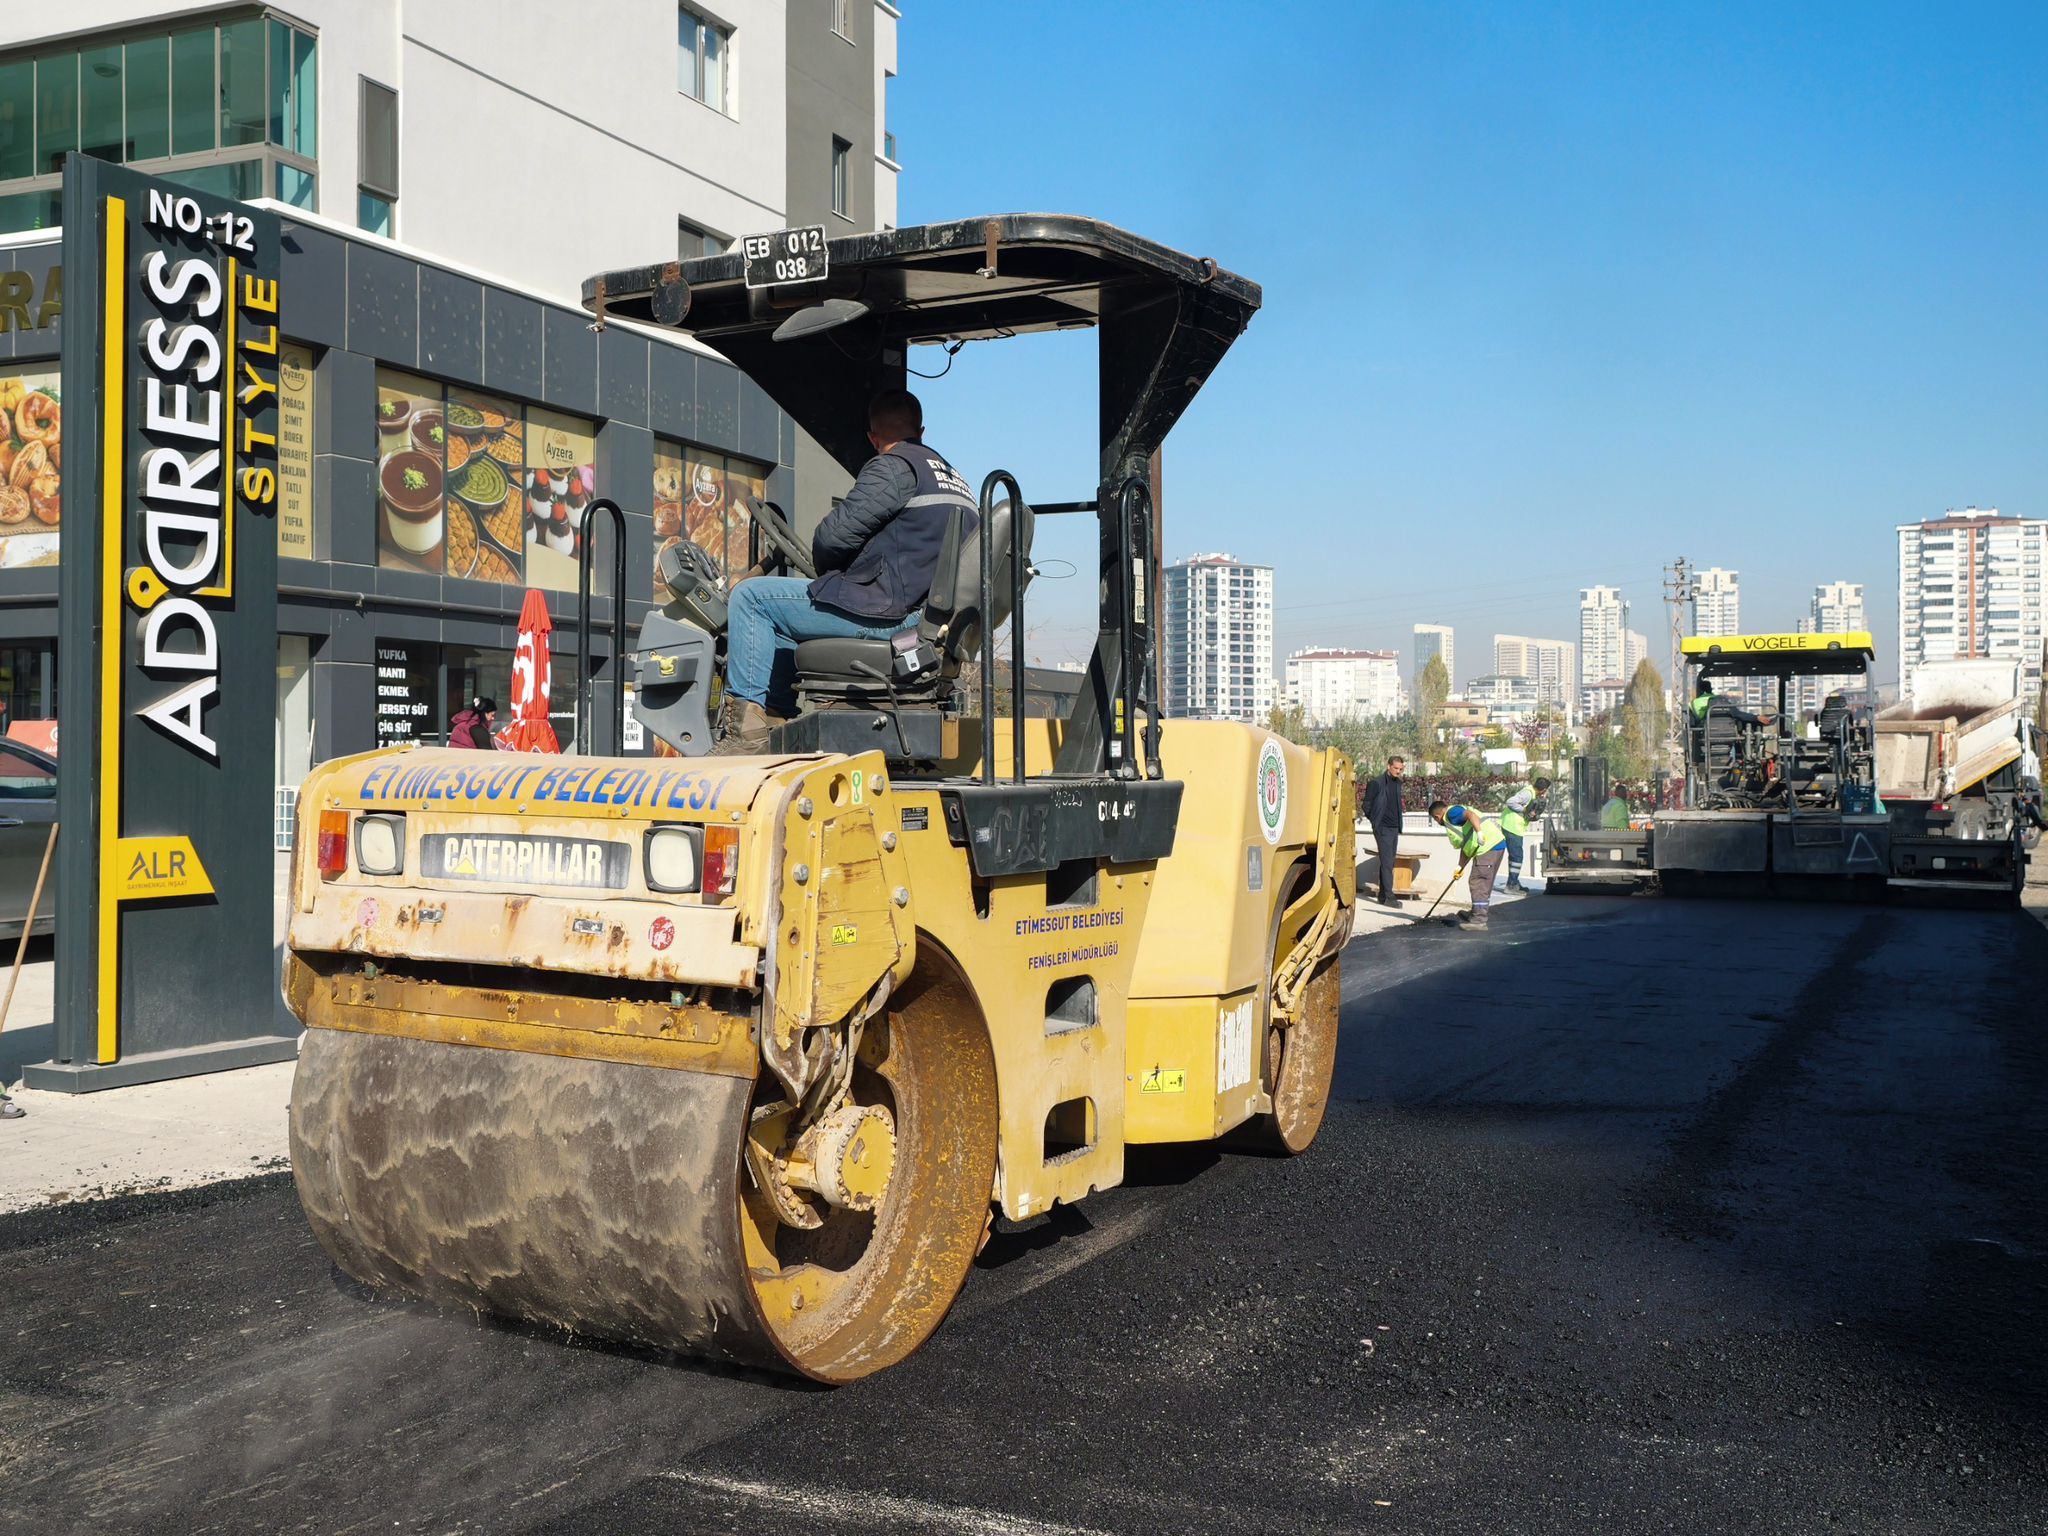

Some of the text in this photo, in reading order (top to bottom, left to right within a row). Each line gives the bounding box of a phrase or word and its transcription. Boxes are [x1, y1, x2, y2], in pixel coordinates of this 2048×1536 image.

[149, 188, 255, 252] NO:12
[745, 230, 821, 259] EB 012
[775, 257, 807, 280] 038
[282, 367, 305, 381] Ayzera
[243, 274, 277, 503] STYLE
[546, 442, 574, 460] Ayzera
[138, 250, 221, 757] ADDRESS
[378, 648, 407, 661] YUFKA
[378, 667, 406, 679] MANTI
[378, 685, 409, 697] EKMEK
[378, 702, 428, 716] JERSEY SÜT
[394, 720, 412, 733] SÜT
[128, 850, 187, 881] ALR
[444, 837, 603, 881] CATERPILLAR
[1015, 907, 1124, 936] ETİMESGUT BELEDİYESİ
[1028, 940, 1119, 970] FENİŞLERİ MÜDÜRLÜĞÜ
